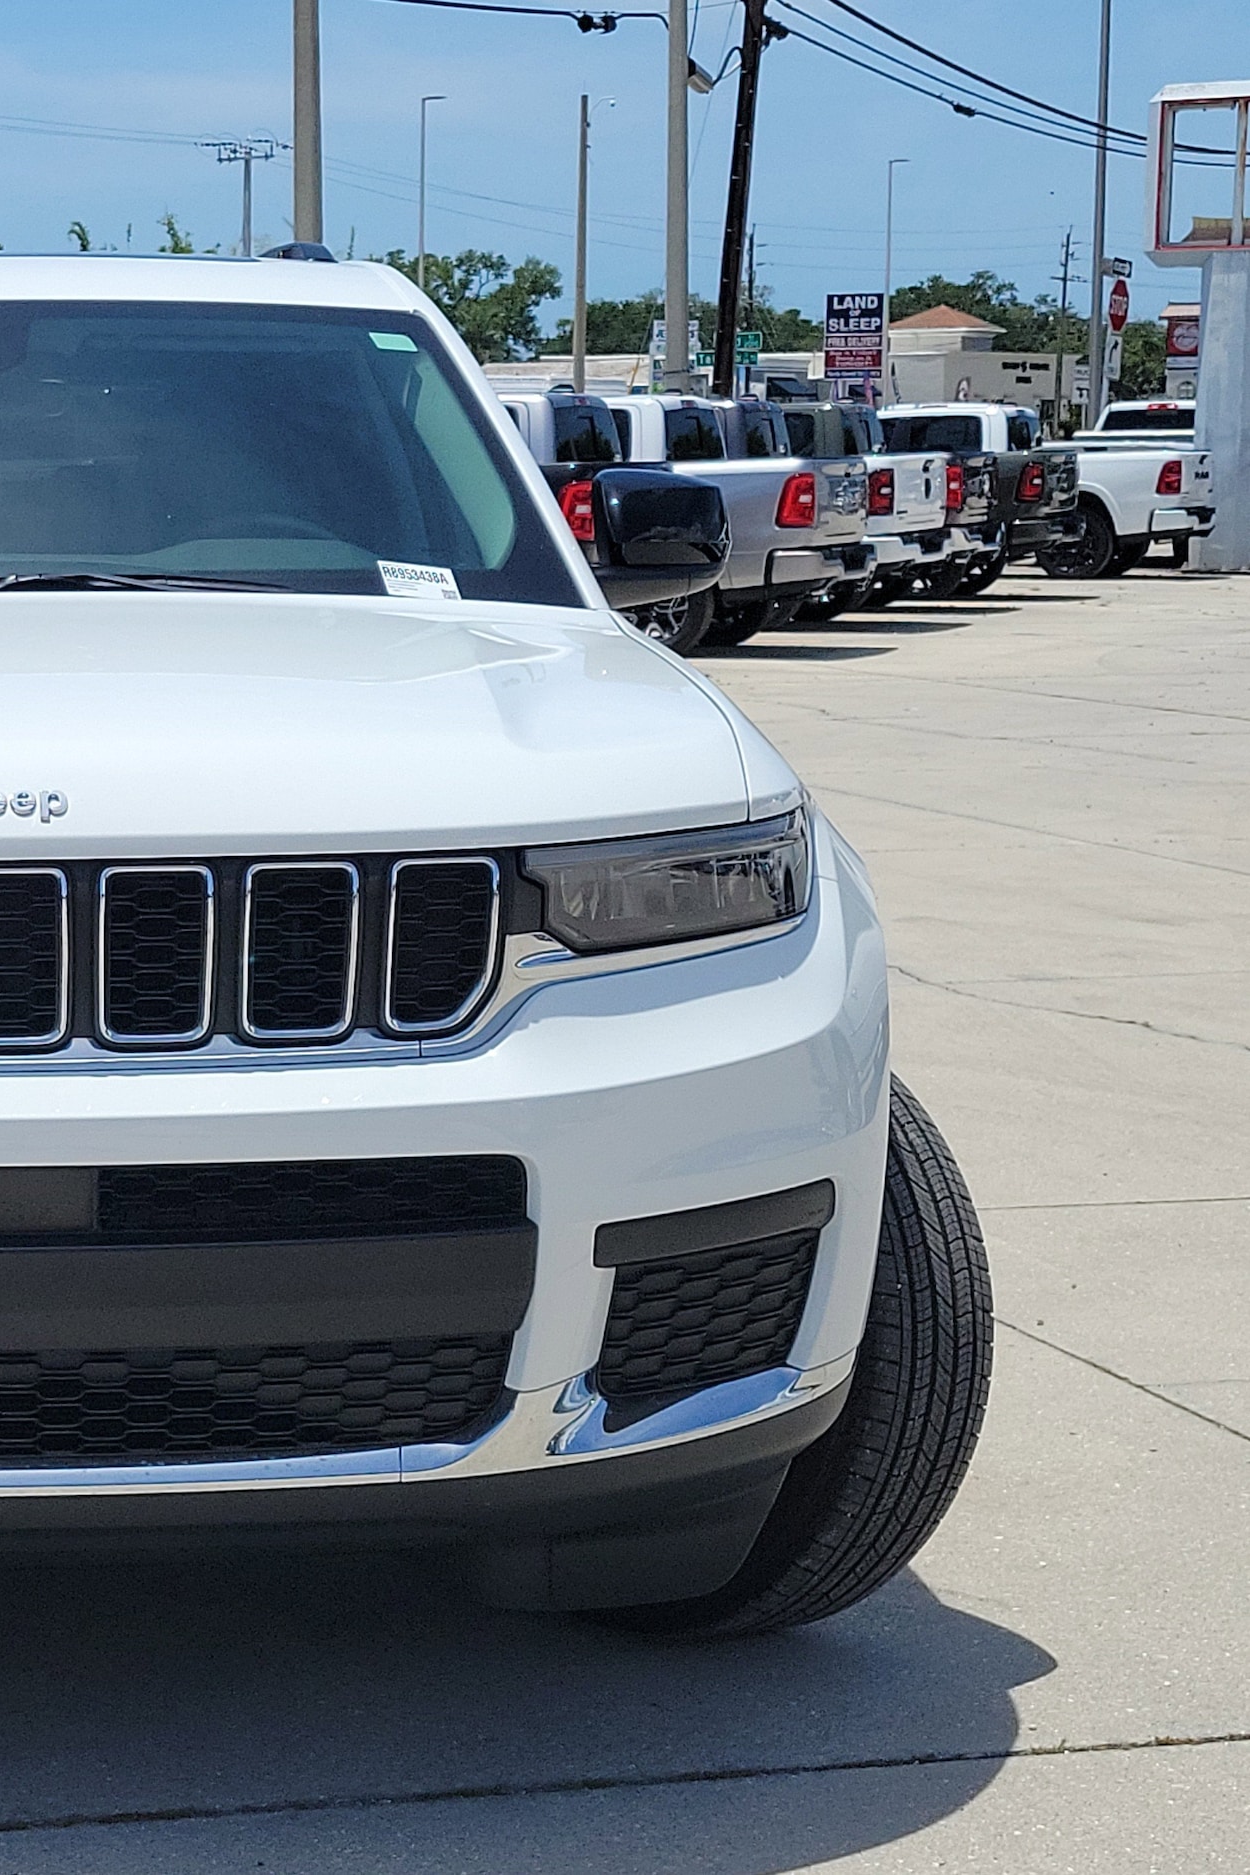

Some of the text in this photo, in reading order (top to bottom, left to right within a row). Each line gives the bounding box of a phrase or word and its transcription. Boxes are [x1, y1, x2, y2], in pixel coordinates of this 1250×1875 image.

[833, 296, 879, 310] LAND
[1110, 294, 1128, 317] STOP
[828, 317, 881, 332] SLEEP
[382, 566, 450, 585] R8953438A
